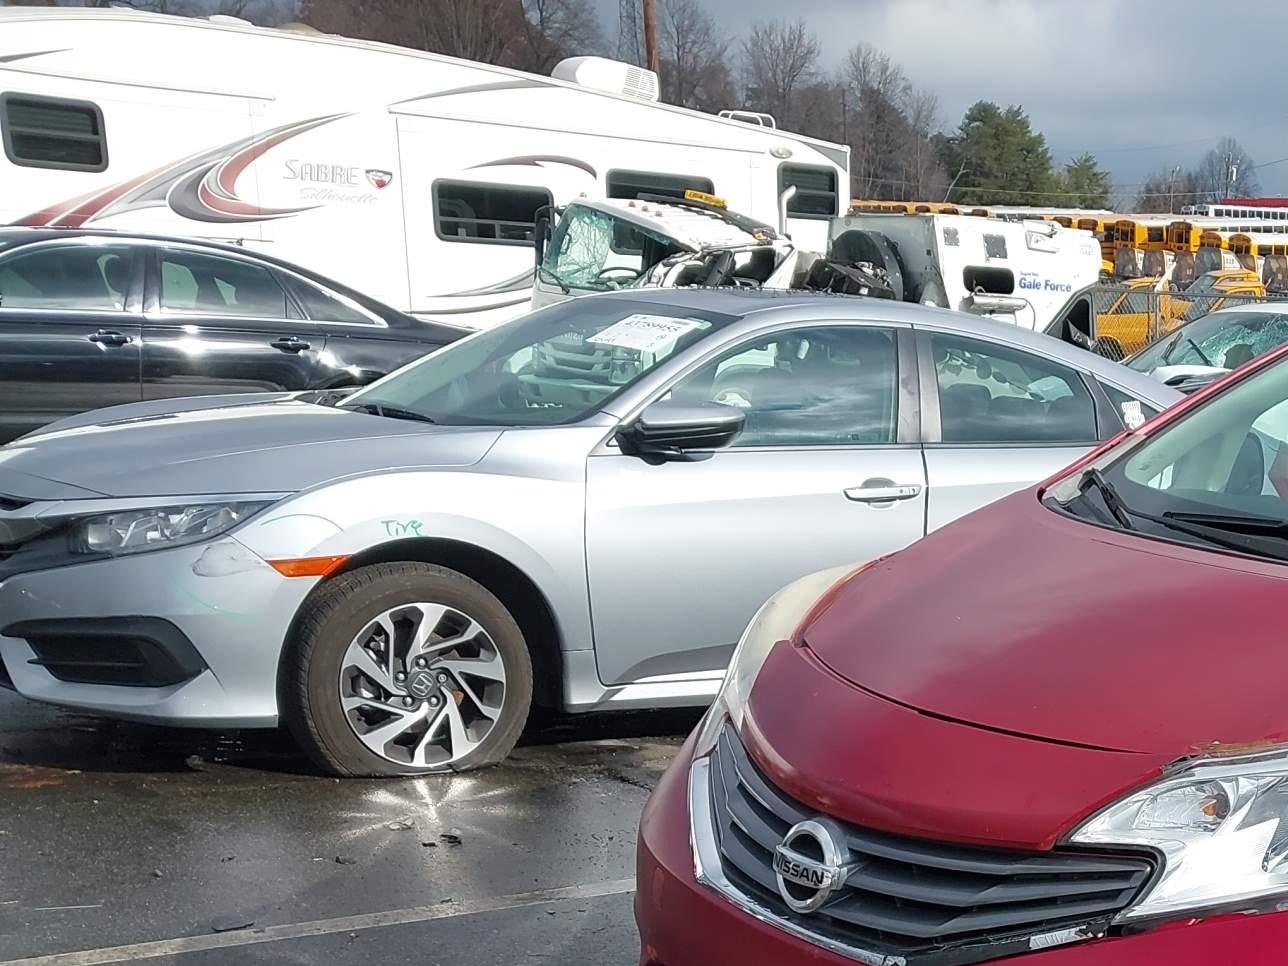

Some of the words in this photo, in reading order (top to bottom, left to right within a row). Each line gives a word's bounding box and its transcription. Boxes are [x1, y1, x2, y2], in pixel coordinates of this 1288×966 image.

[282, 159, 360, 185] SABRE
[1018, 277, 1041, 290] Gale
[1044, 279, 1072, 292] Force
[774, 851, 825, 885] NISSAN
